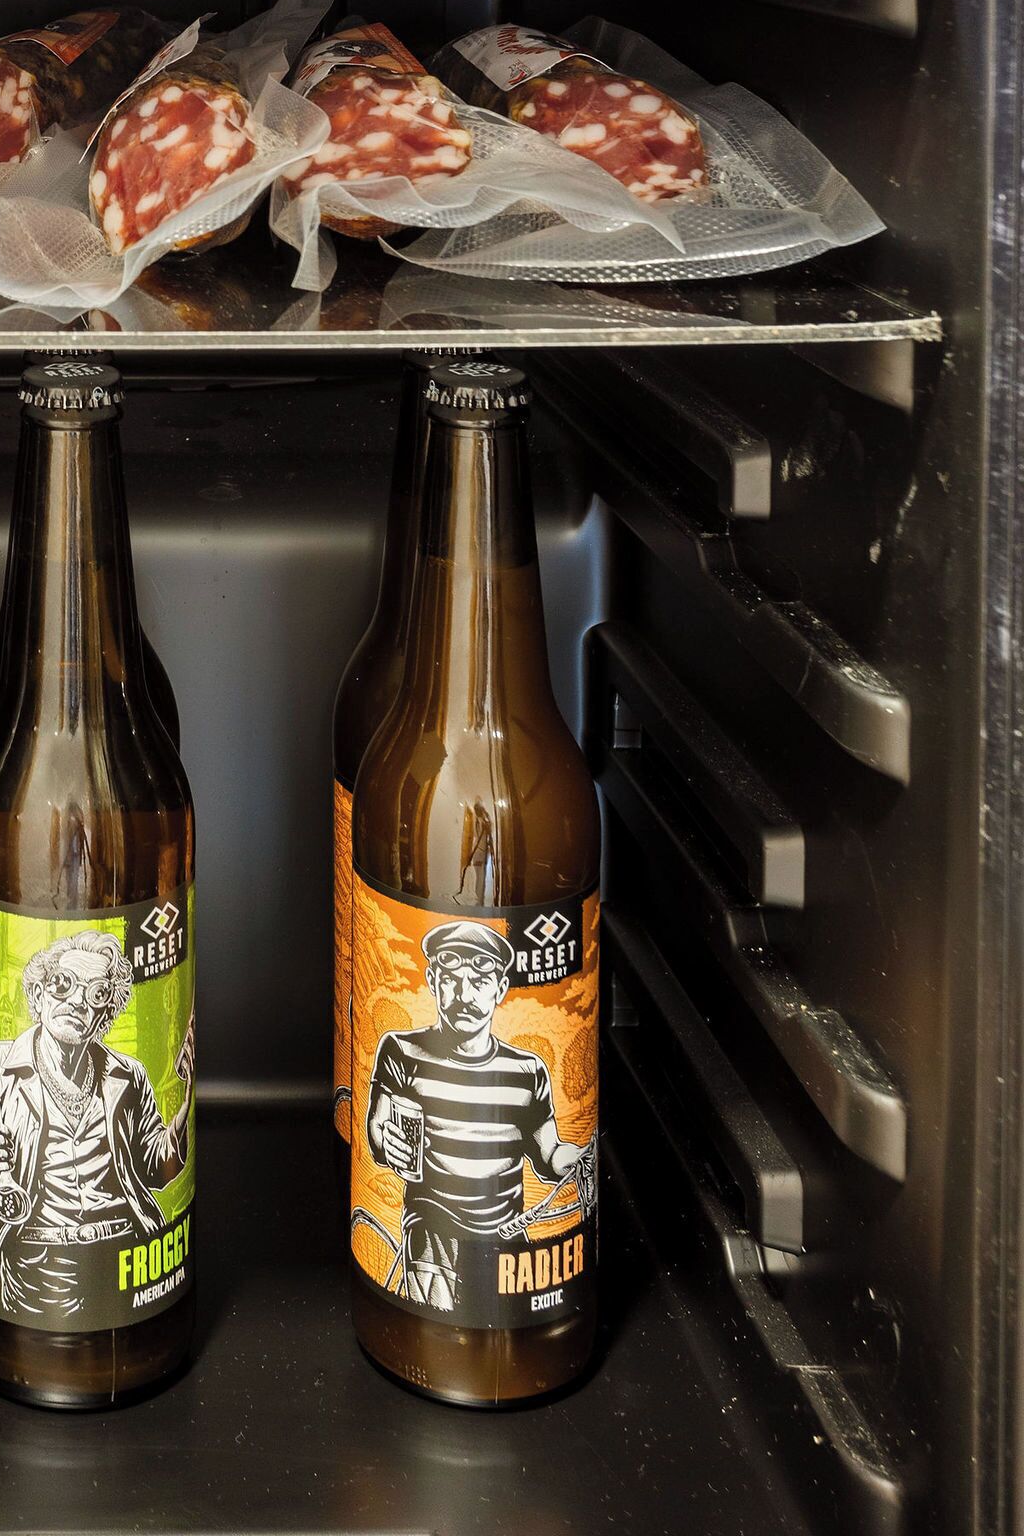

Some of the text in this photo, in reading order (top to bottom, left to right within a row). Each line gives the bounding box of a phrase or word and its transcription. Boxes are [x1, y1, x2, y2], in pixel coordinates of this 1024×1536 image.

[133, 927, 183, 968] RESET
[144, 954, 177, 977] BREWERY
[516, 939, 576, 973] RESET
[527, 965, 568, 984] BREWERY
[118, 1213, 190, 1291] FROGGY
[497, 1233, 584, 1295] RADLER
[132, 1266, 186, 1309] AMERICAN IPA
[531, 1288, 564, 1312] EXOTIC
